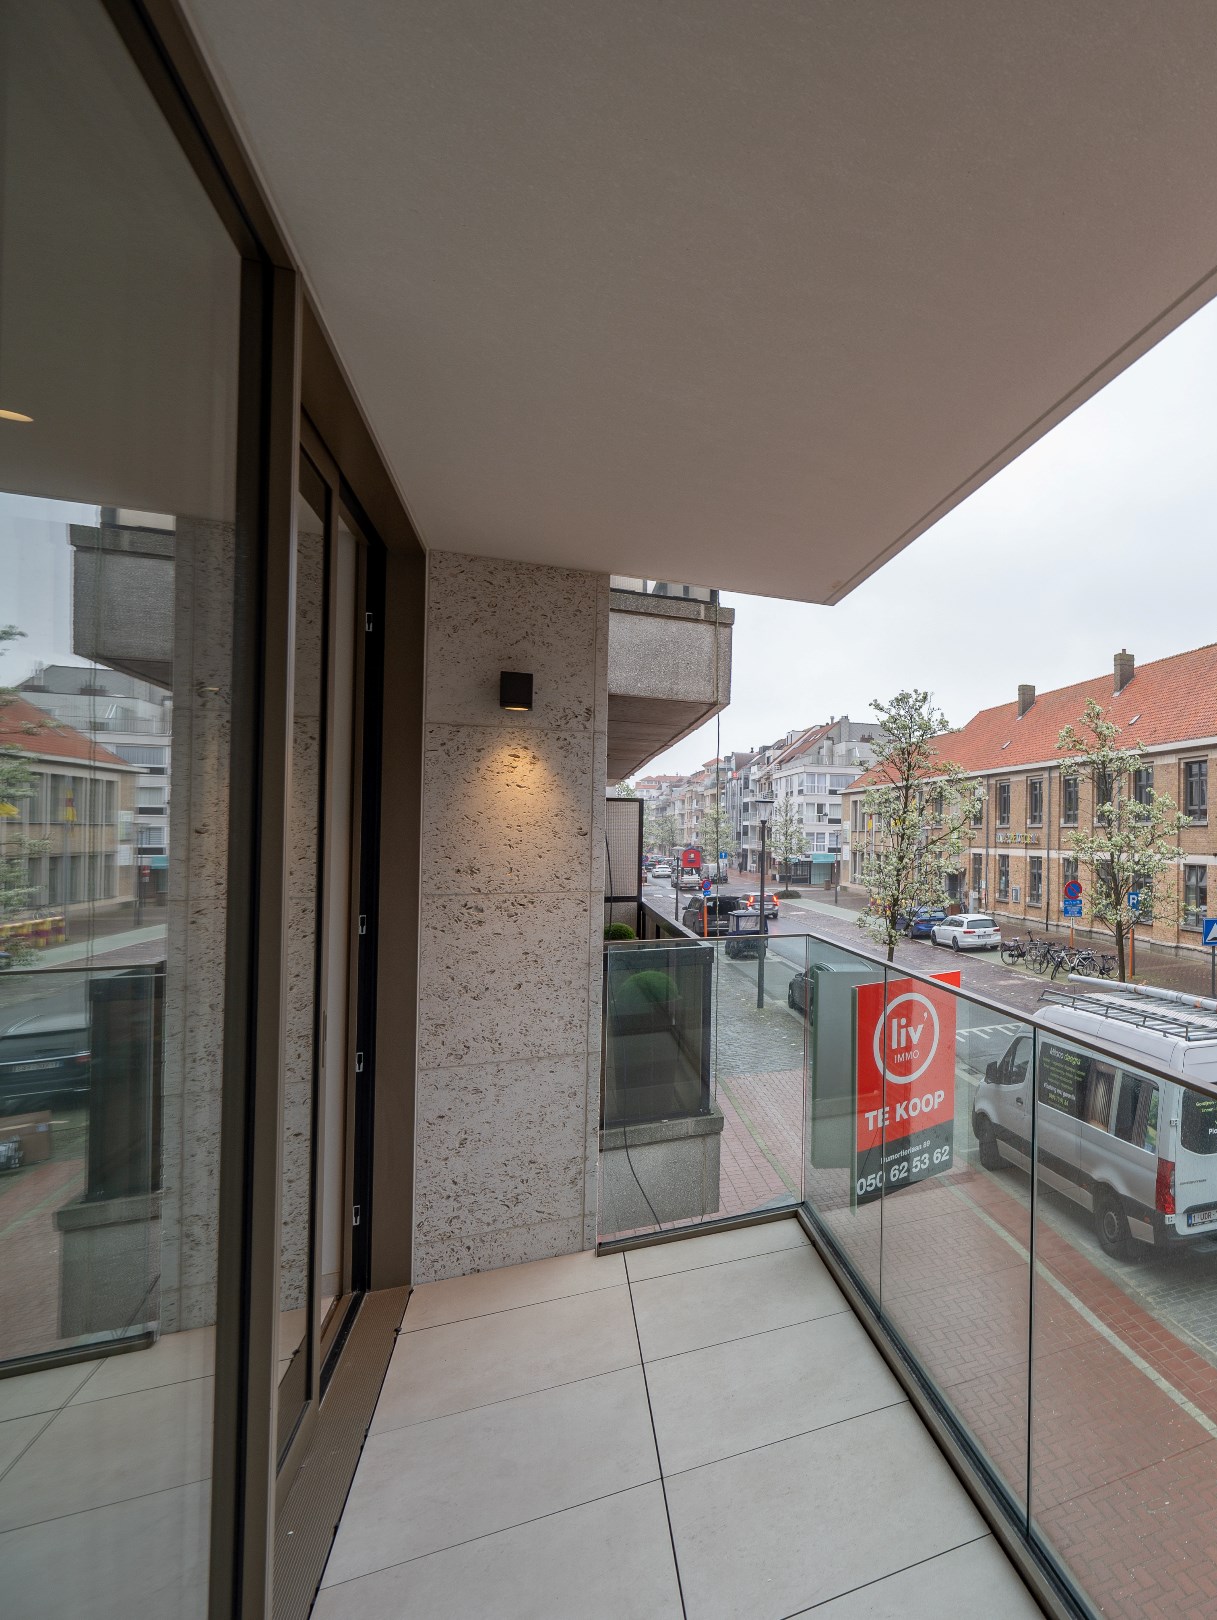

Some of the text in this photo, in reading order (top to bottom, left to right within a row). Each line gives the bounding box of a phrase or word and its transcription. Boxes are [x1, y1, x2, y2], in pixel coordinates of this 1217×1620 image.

[1129, 894, 1138, 907] P
[894, 1049, 920, 1064] IMMO
[864, 1090, 945, 1131] TE KOOP
[857, 1145, 950, 1196] 050 62 53 62
